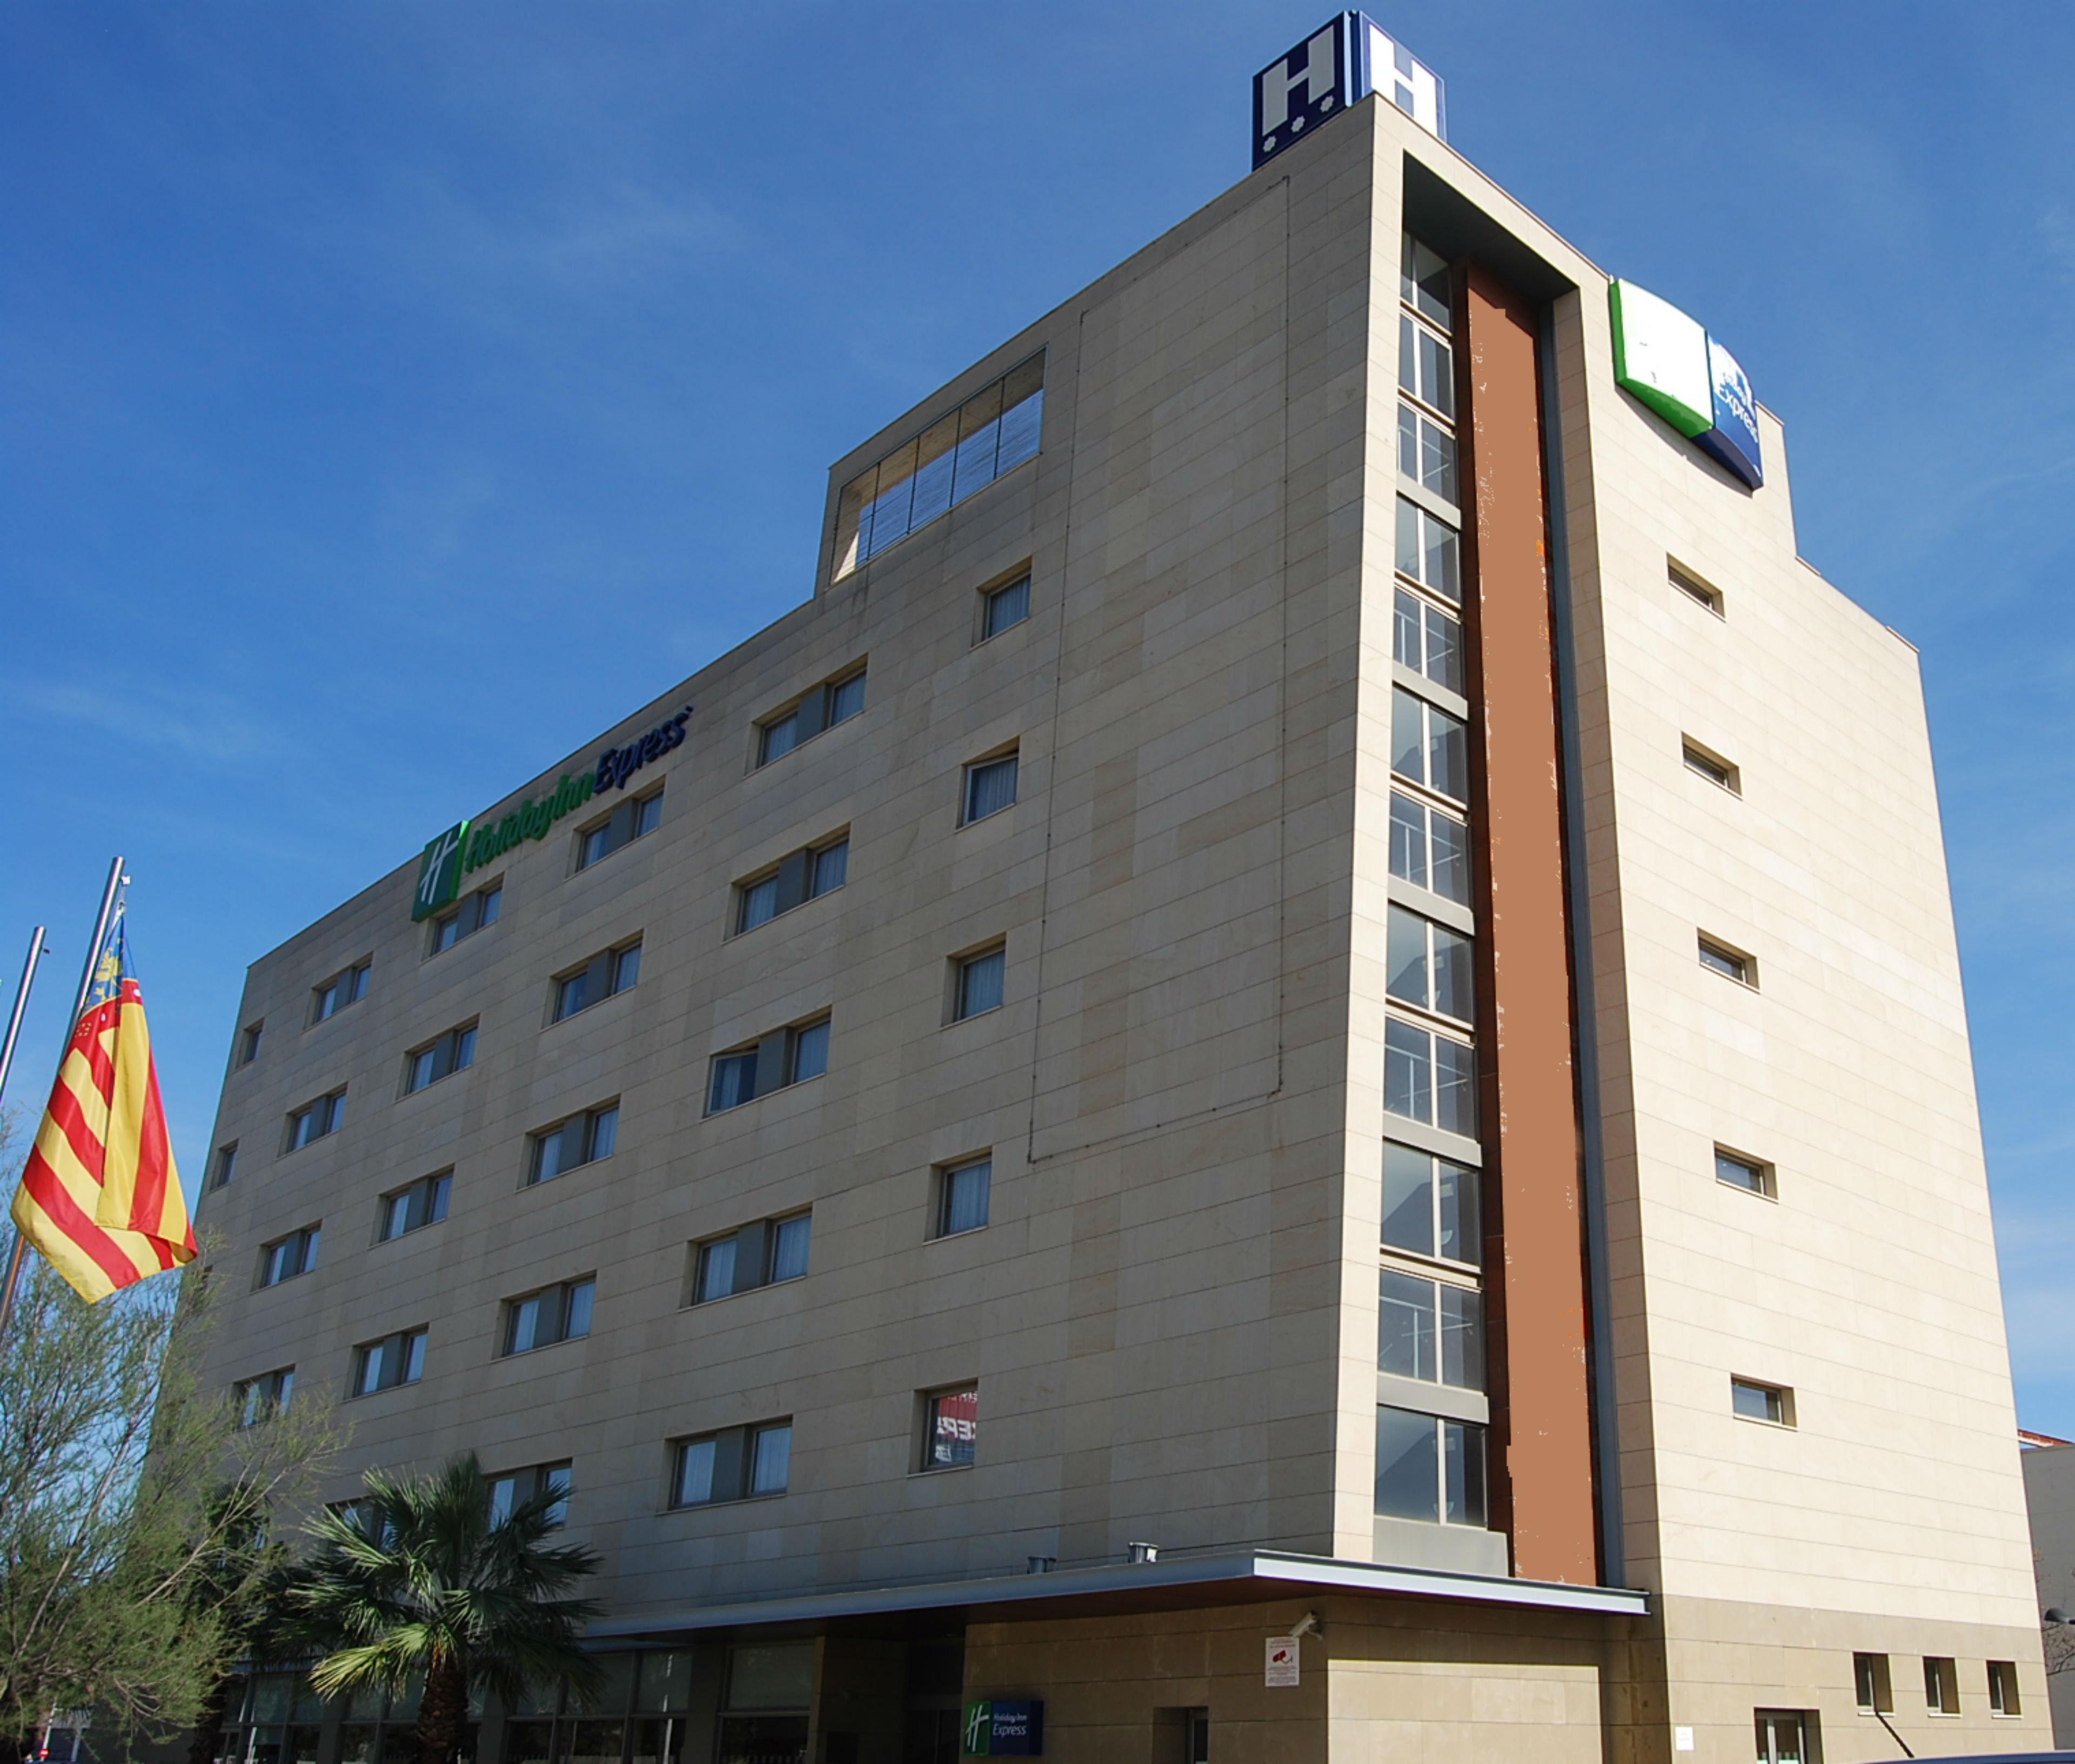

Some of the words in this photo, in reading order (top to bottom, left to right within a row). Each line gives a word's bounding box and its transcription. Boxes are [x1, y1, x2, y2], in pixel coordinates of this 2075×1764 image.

[1262, 24, 1335, 137] H
[1369, 24, 1438, 137] H
[465, 794, 555, 874] Holiday
[593, 705, 693, 794] Express
[992, 1723, 1027, 1739] Express
